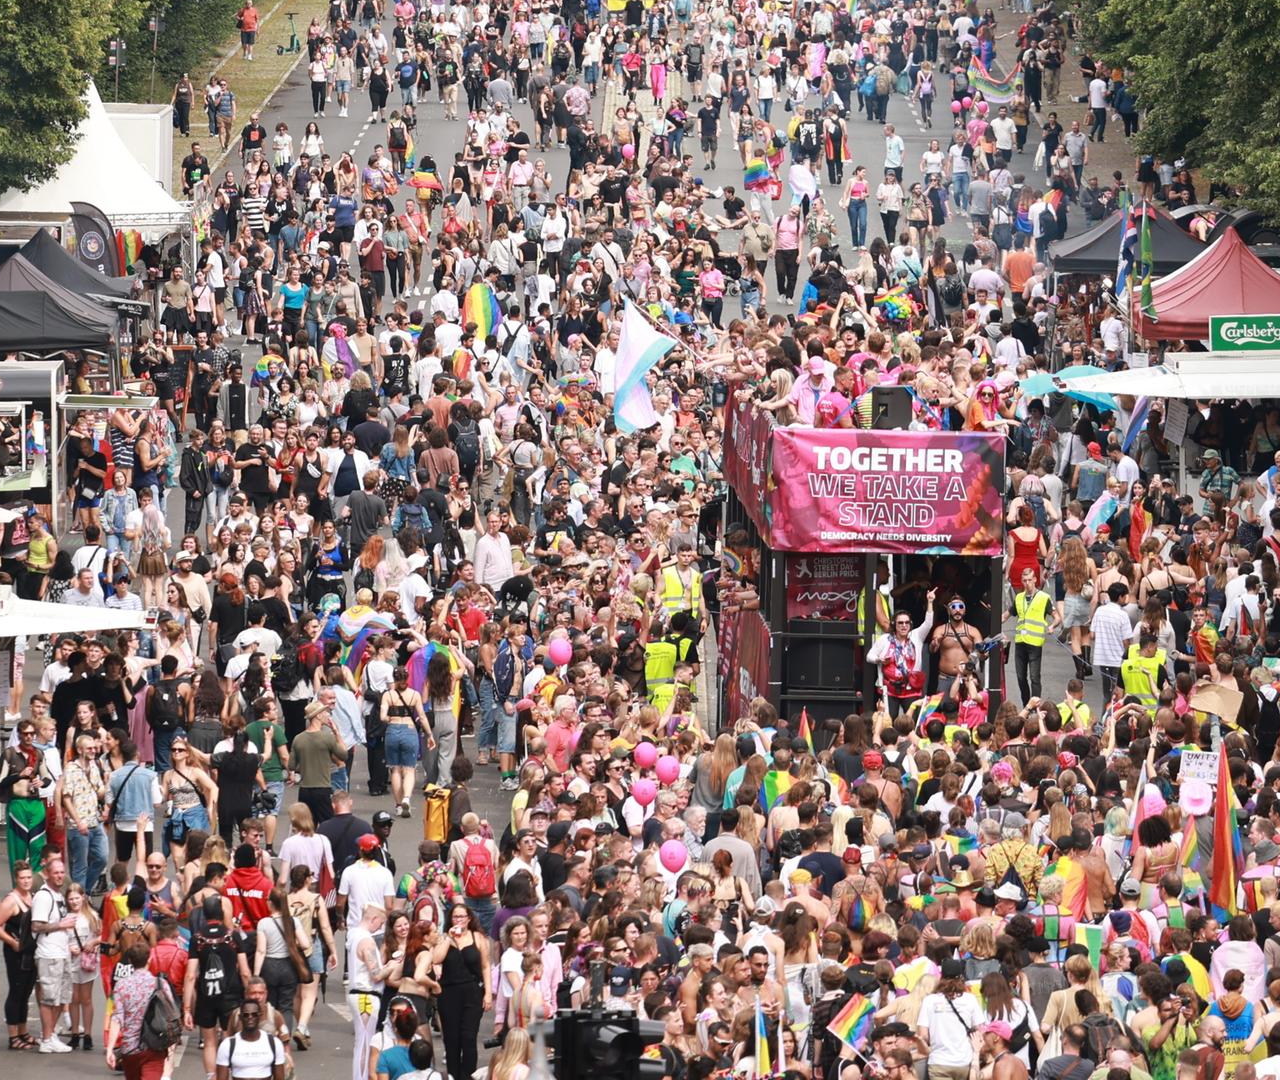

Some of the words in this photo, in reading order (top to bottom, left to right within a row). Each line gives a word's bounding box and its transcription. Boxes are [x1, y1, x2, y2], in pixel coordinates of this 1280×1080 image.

[812, 446, 964, 473] TOGETHER
[807, 472, 856, 499] WE
[862, 474, 939, 501] TAKE
[943, 476, 968, 501] A
[838, 501, 935, 528] STAND
[821, 531, 874, 541] DEMOCRACY
[876, 532, 905, 541] NEEDS
[906, 533, 953, 543] DIVERSITY
[813, 570, 838, 578] BERLIN
[1187, 753, 1218, 761] UNITY
[206, 980, 223, 996] 71
